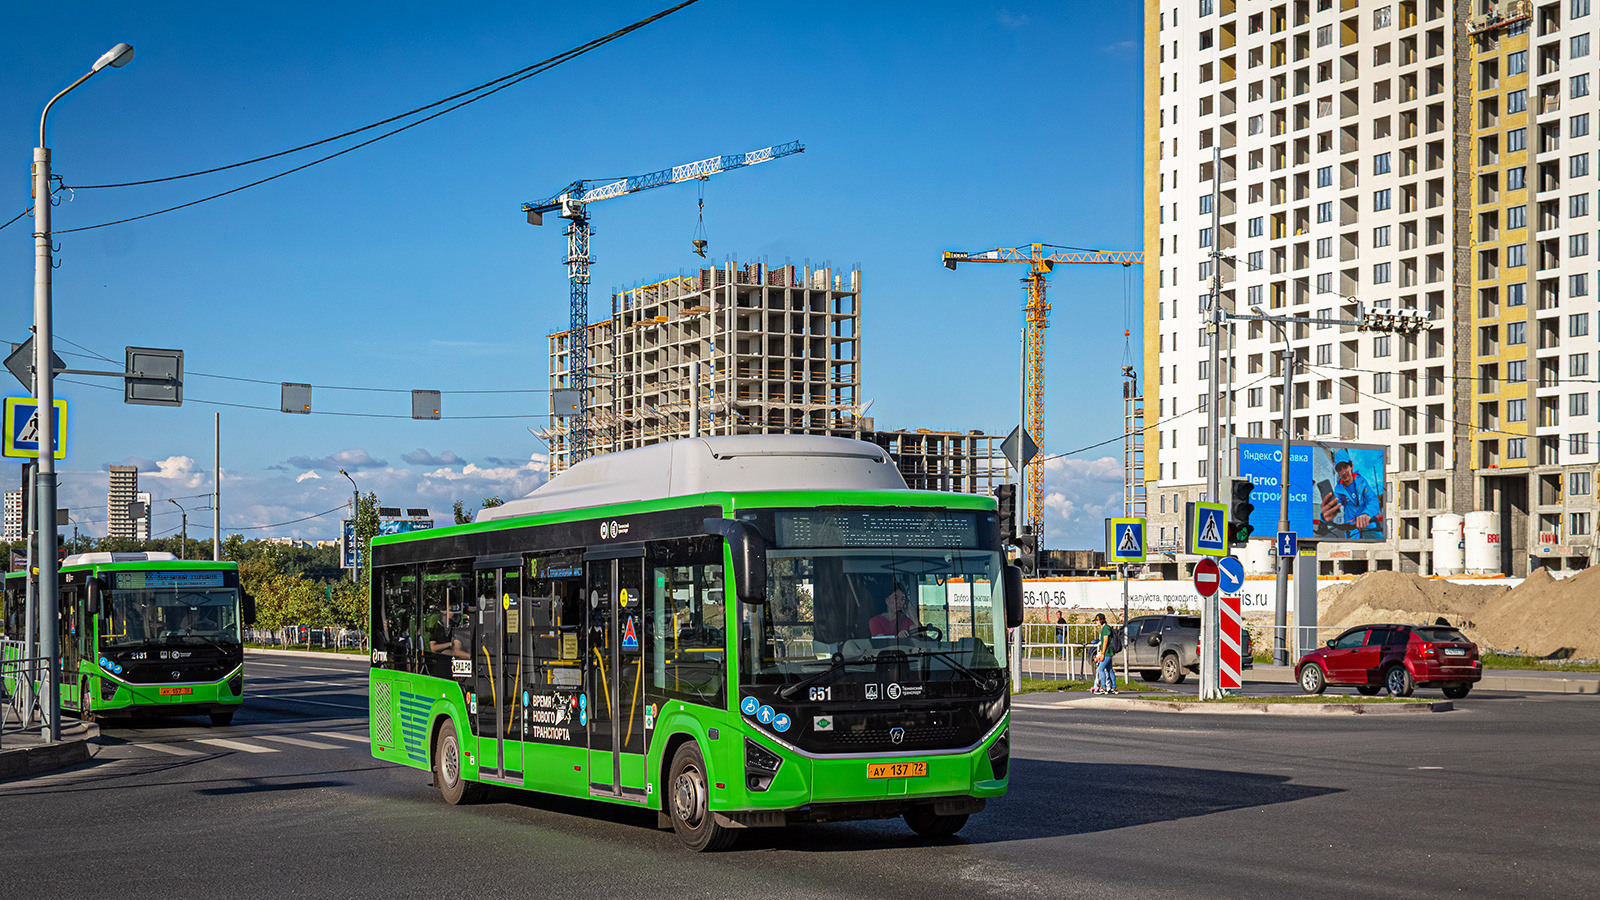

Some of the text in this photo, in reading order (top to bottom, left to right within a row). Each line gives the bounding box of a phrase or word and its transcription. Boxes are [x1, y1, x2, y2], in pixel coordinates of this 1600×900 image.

[1243, 449, 1309, 463] Яндекс авка
[1024, 590, 1067, 606] 56-10-56
[1120, 592, 1198, 603] Пжалуйста, проходите
[130, 651, 148, 660] 2131
[808, 686, 832, 701] 651
[532, 694, 552, 708] ВРЕМЯ
[532, 710, 556, 724] НОВОГО
[532, 725, 571, 741] ТРАНСПОРТА
[873, 763, 924, 777] АУ 137 72
